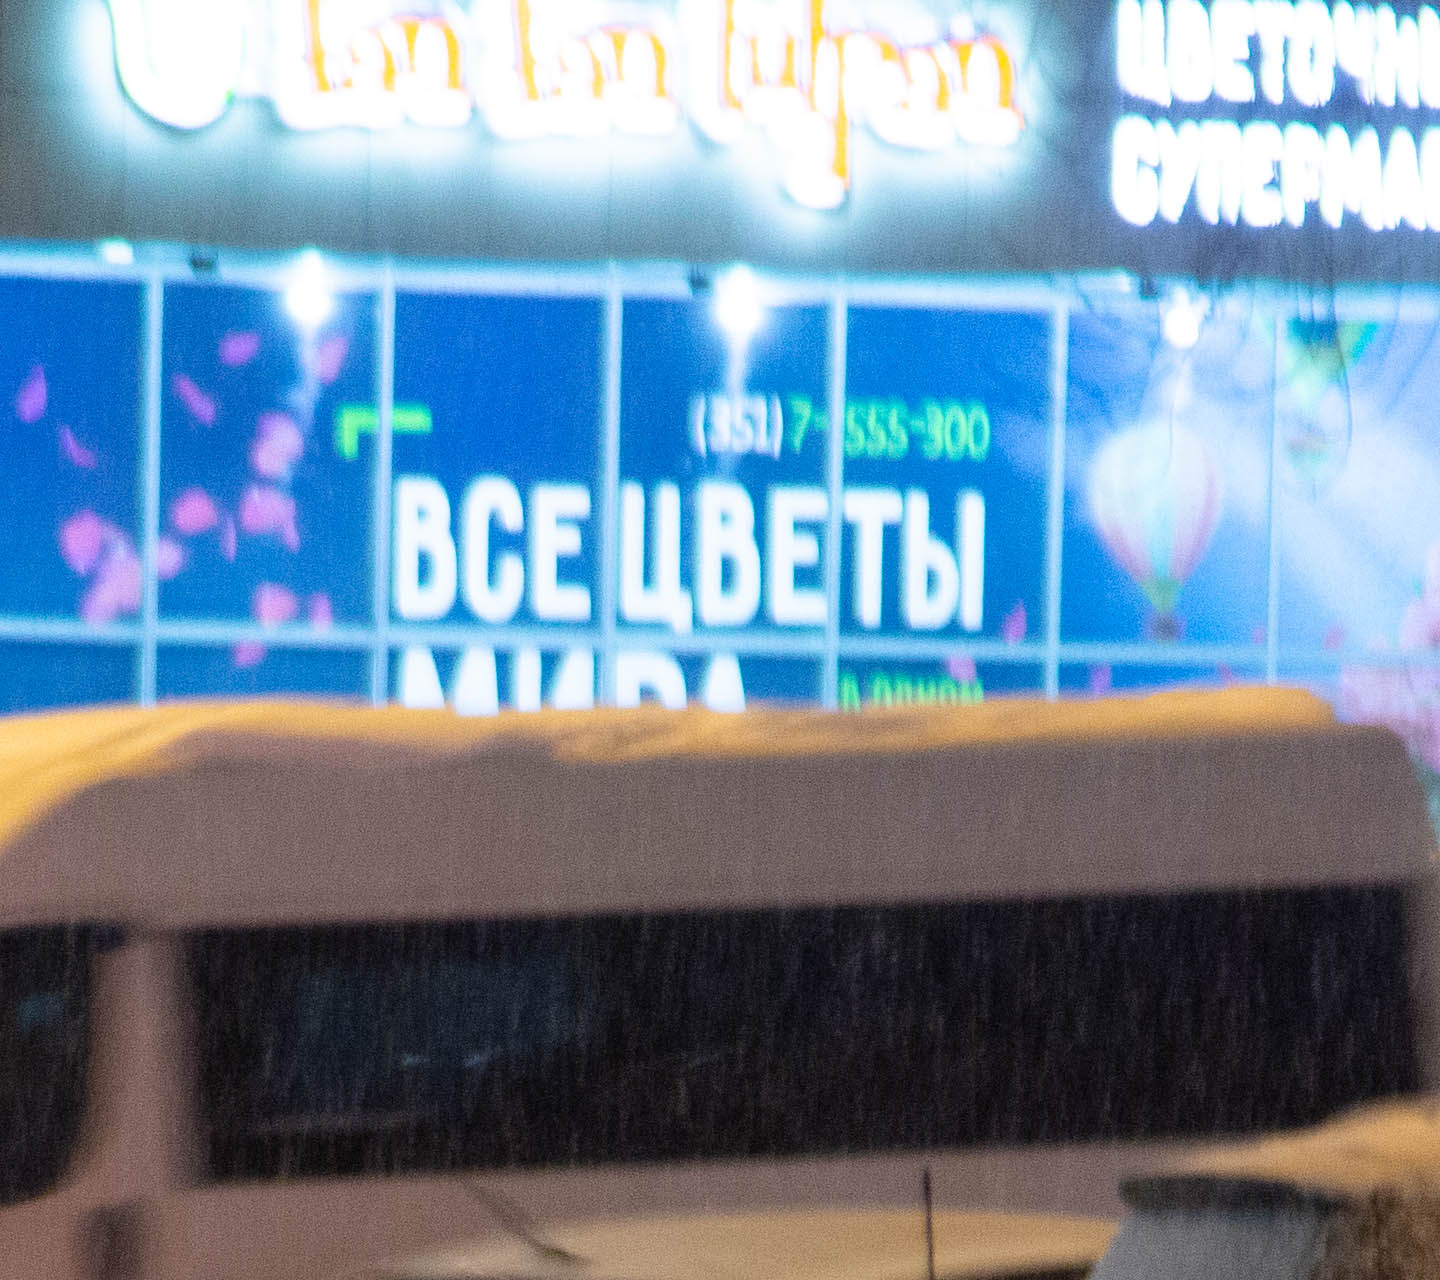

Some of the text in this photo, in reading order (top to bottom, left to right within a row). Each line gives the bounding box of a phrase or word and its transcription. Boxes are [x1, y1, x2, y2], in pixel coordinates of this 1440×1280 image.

[691, 392, 784, 458] (351)
[392, 472, 987, 636] ВСЕ ЦВЕТЫ
